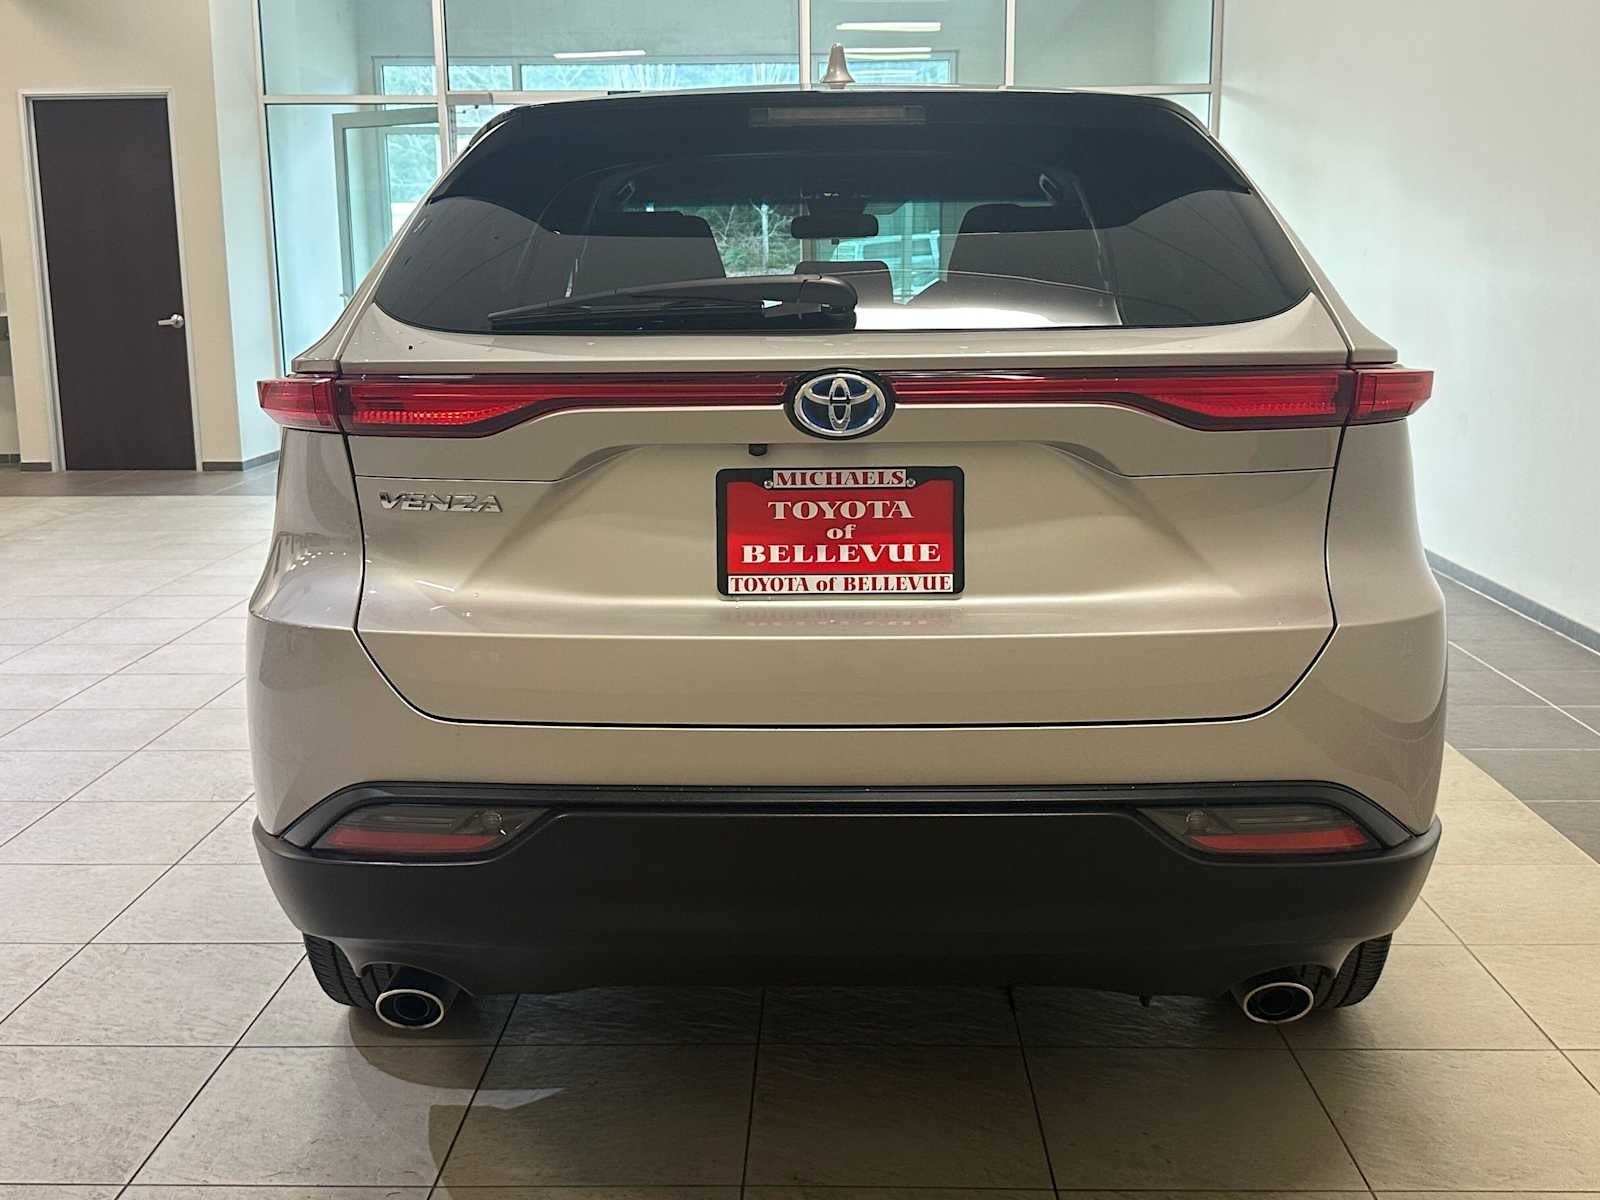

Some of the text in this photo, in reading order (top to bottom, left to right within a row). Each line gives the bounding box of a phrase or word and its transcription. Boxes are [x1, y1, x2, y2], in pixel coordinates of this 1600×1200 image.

[775, 471, 905, 486] MICHAELS
[380, 492, 503, 512] VENZA
[768, 500, 914, 520] TOYOTA
[826, 524, 856, 540] of
[741, 543, 941, 563] BELLEVUE
[730, 575, 951, 592] TOYOTA of BELLEVUE
